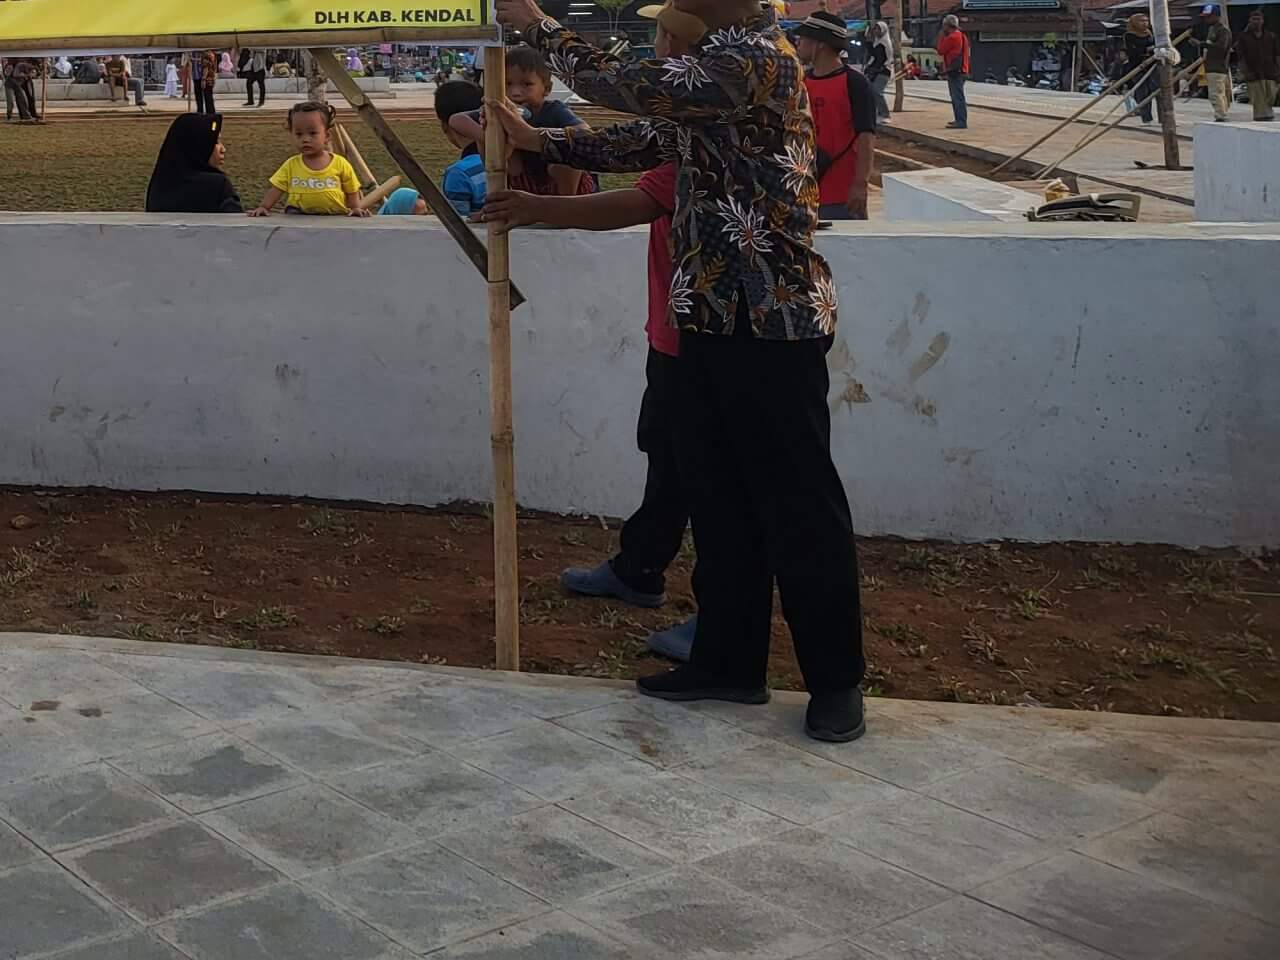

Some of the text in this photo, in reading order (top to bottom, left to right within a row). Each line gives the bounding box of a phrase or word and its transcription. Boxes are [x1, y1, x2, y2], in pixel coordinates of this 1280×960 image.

[314, 9, 475, 24] DLH KAB. KENDAL
